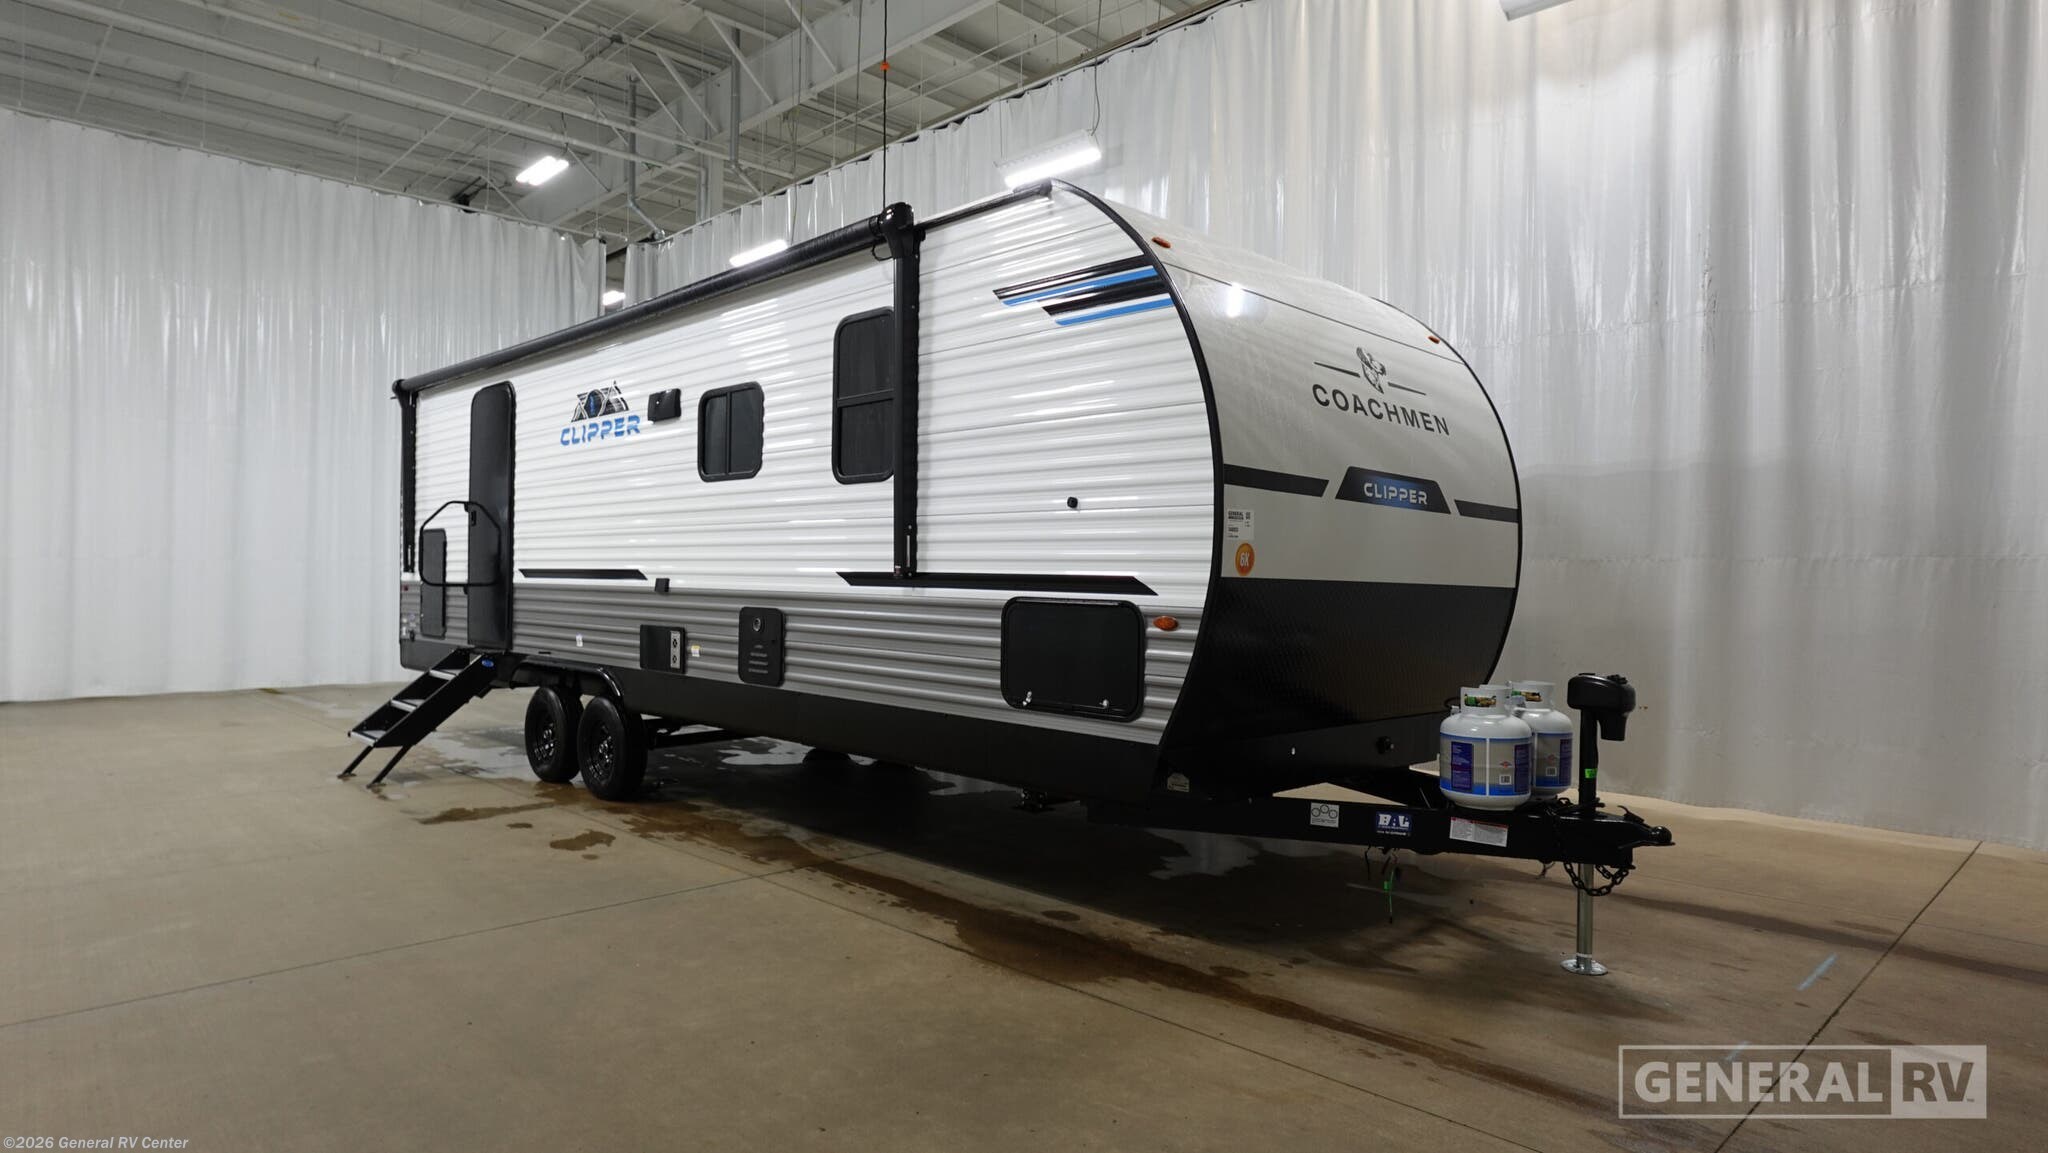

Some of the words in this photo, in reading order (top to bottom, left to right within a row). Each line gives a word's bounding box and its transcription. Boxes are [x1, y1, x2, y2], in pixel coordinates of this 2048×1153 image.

[1312, 384, 1450, 436] COACHMEN
[560, 415, 641, 446] CLIPPER
[1363, 482, 1428, 505] CLIPPER
